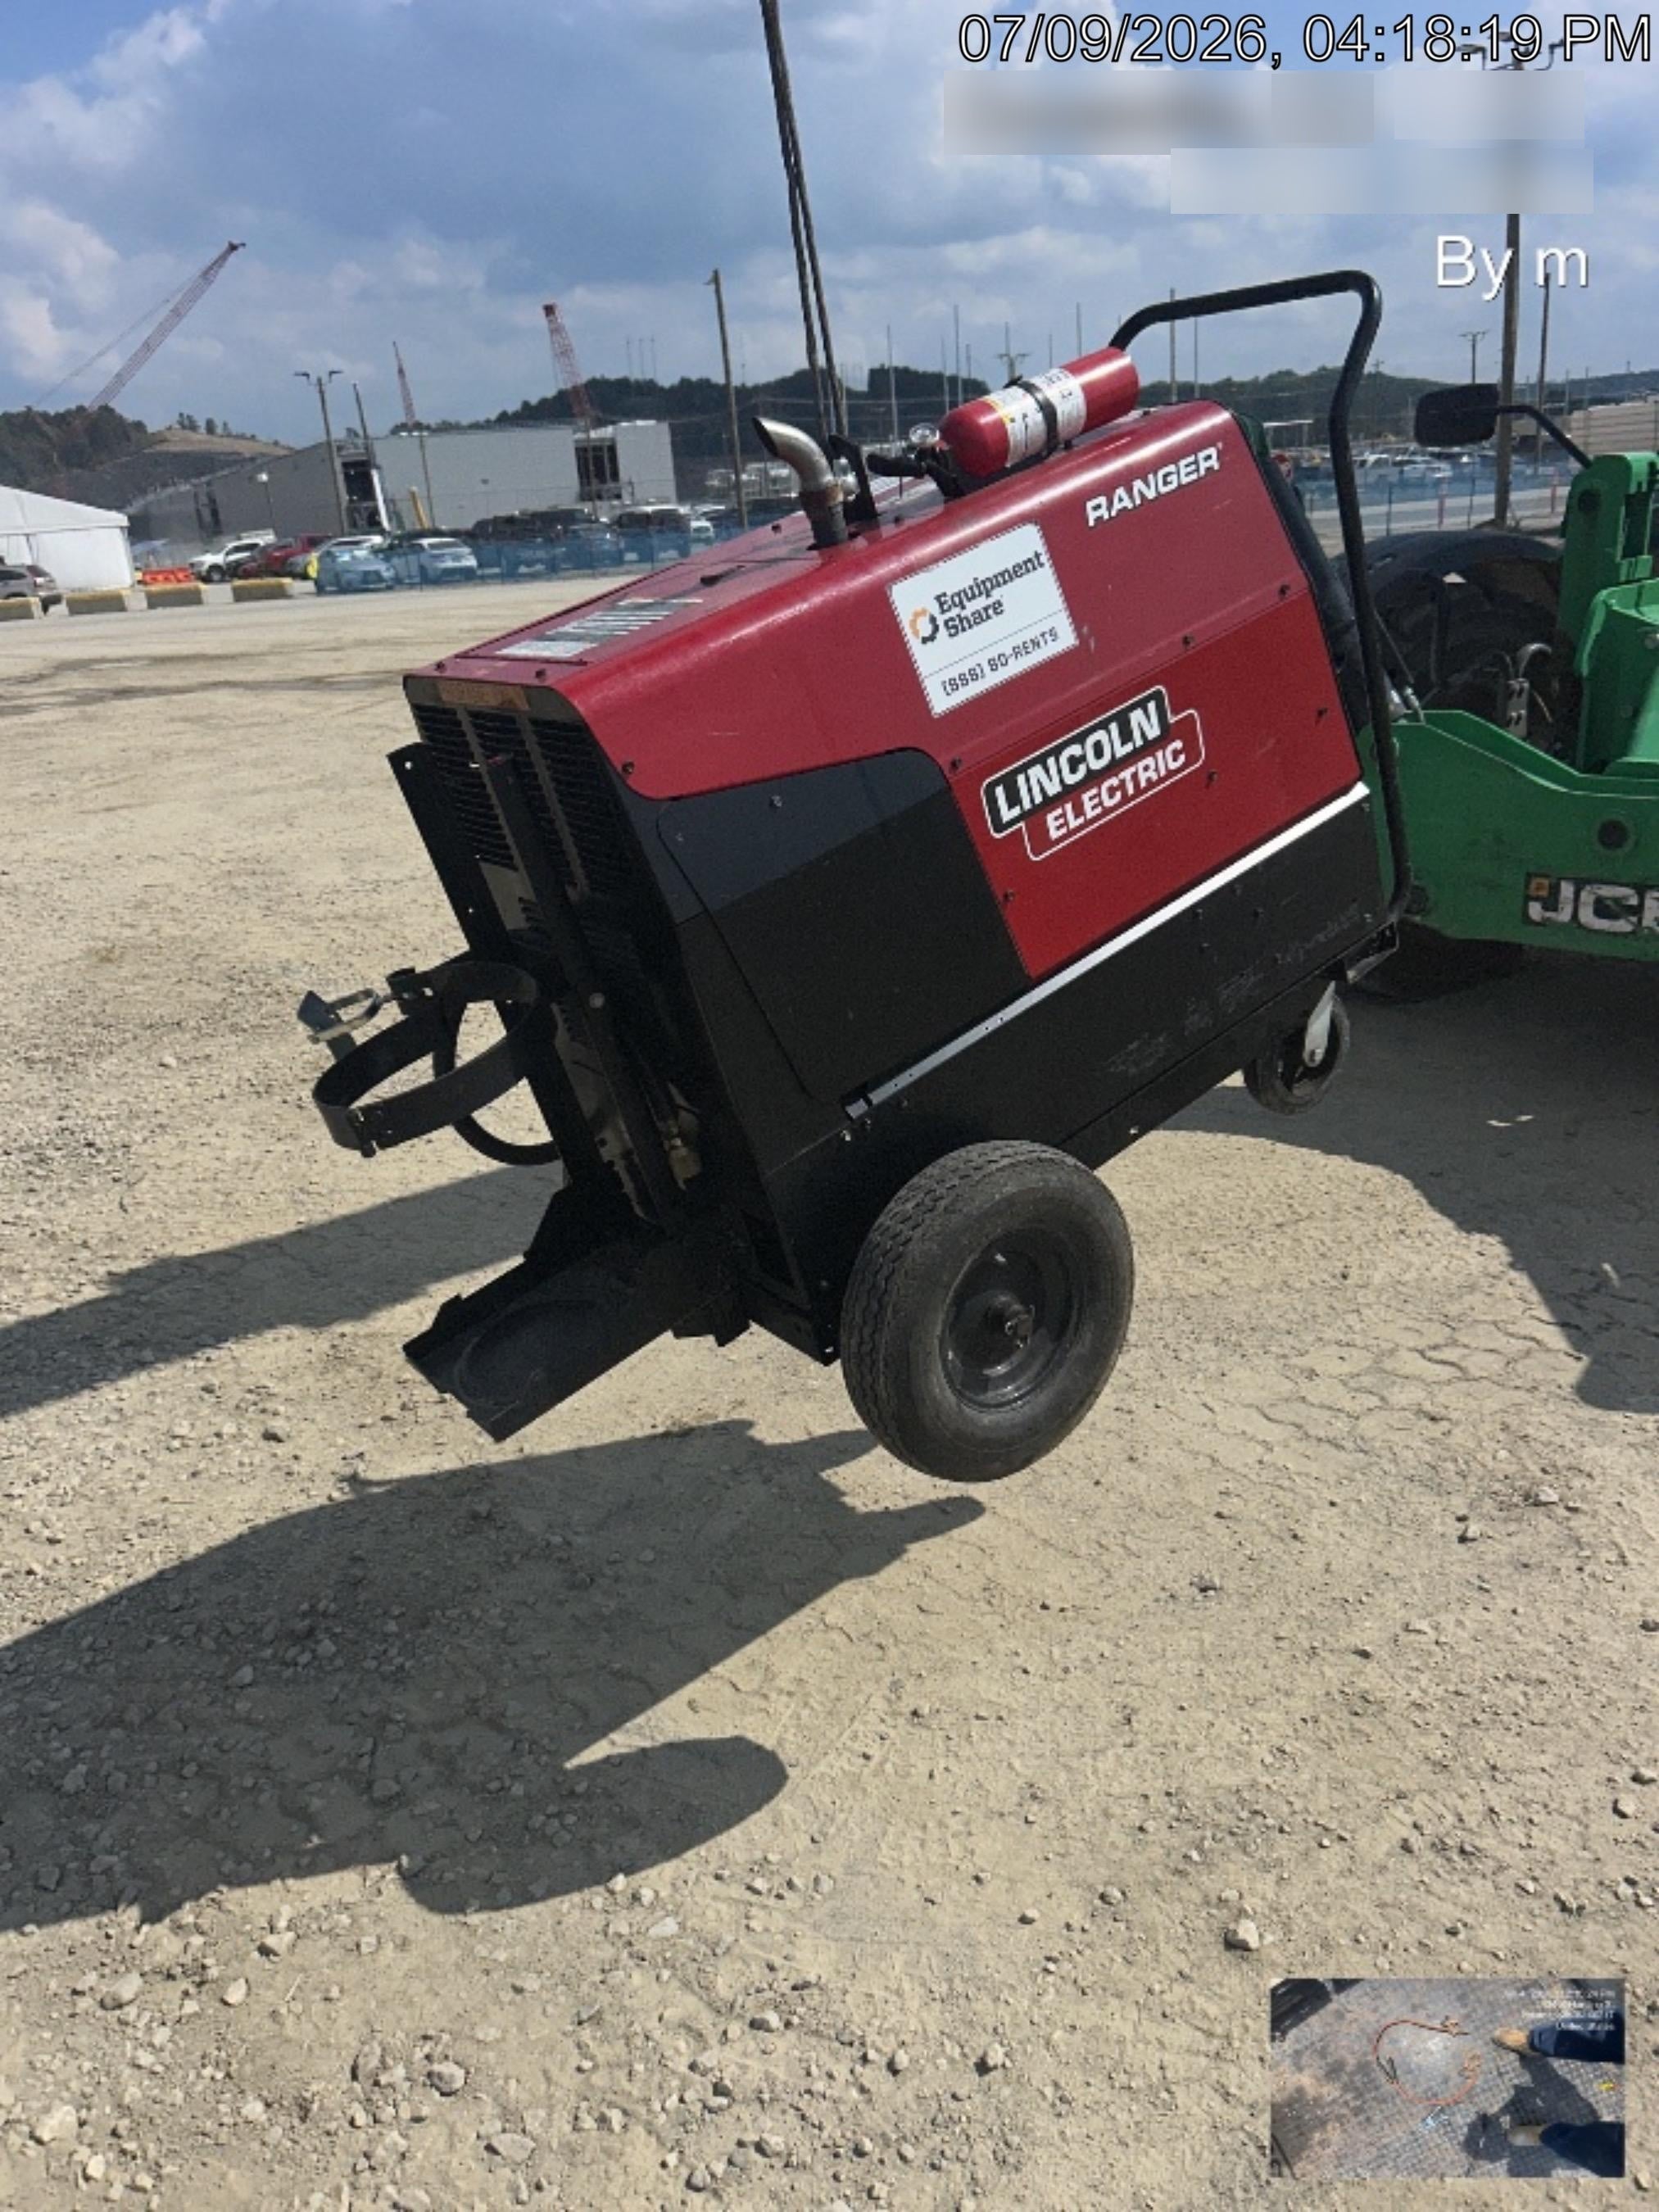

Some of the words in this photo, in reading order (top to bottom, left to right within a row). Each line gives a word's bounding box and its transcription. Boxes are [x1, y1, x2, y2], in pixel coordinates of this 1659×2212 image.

[1086, 446, 1219, 527] RANGER
[934, 551, 1045, 614] Equipment
[943, 599, 1004, 637] Share
[941, 663, 986, 696] (888)
[995, 700, 1162, 824] LINCOLN
[1046, 739, 1185, 841] ELECTRIC
[1527, 877, 1659, 933] JC
